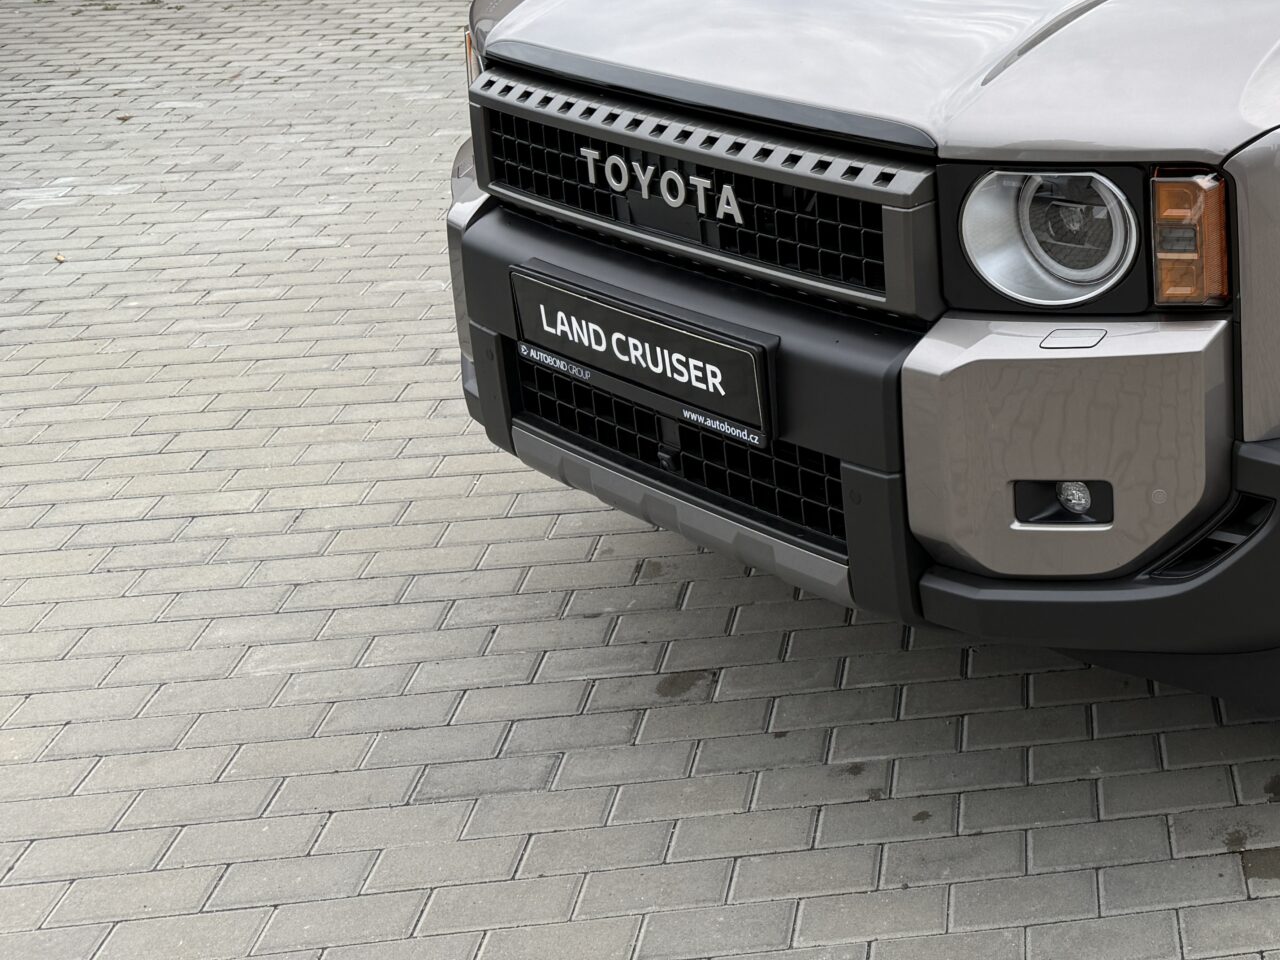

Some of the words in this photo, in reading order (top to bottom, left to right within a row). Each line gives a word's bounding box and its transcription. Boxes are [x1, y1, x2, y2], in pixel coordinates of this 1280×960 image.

[580, 147, 743, 225] TOYOTA
[529, 348, 567, 371] AUTOBOND
[568, 364, 591, 380] GROUP
[539, 304, 607, 353] LAND
[611, 332, 726, 396] CRUISER
[682, 408, 760, 445] www.autobond.cz
